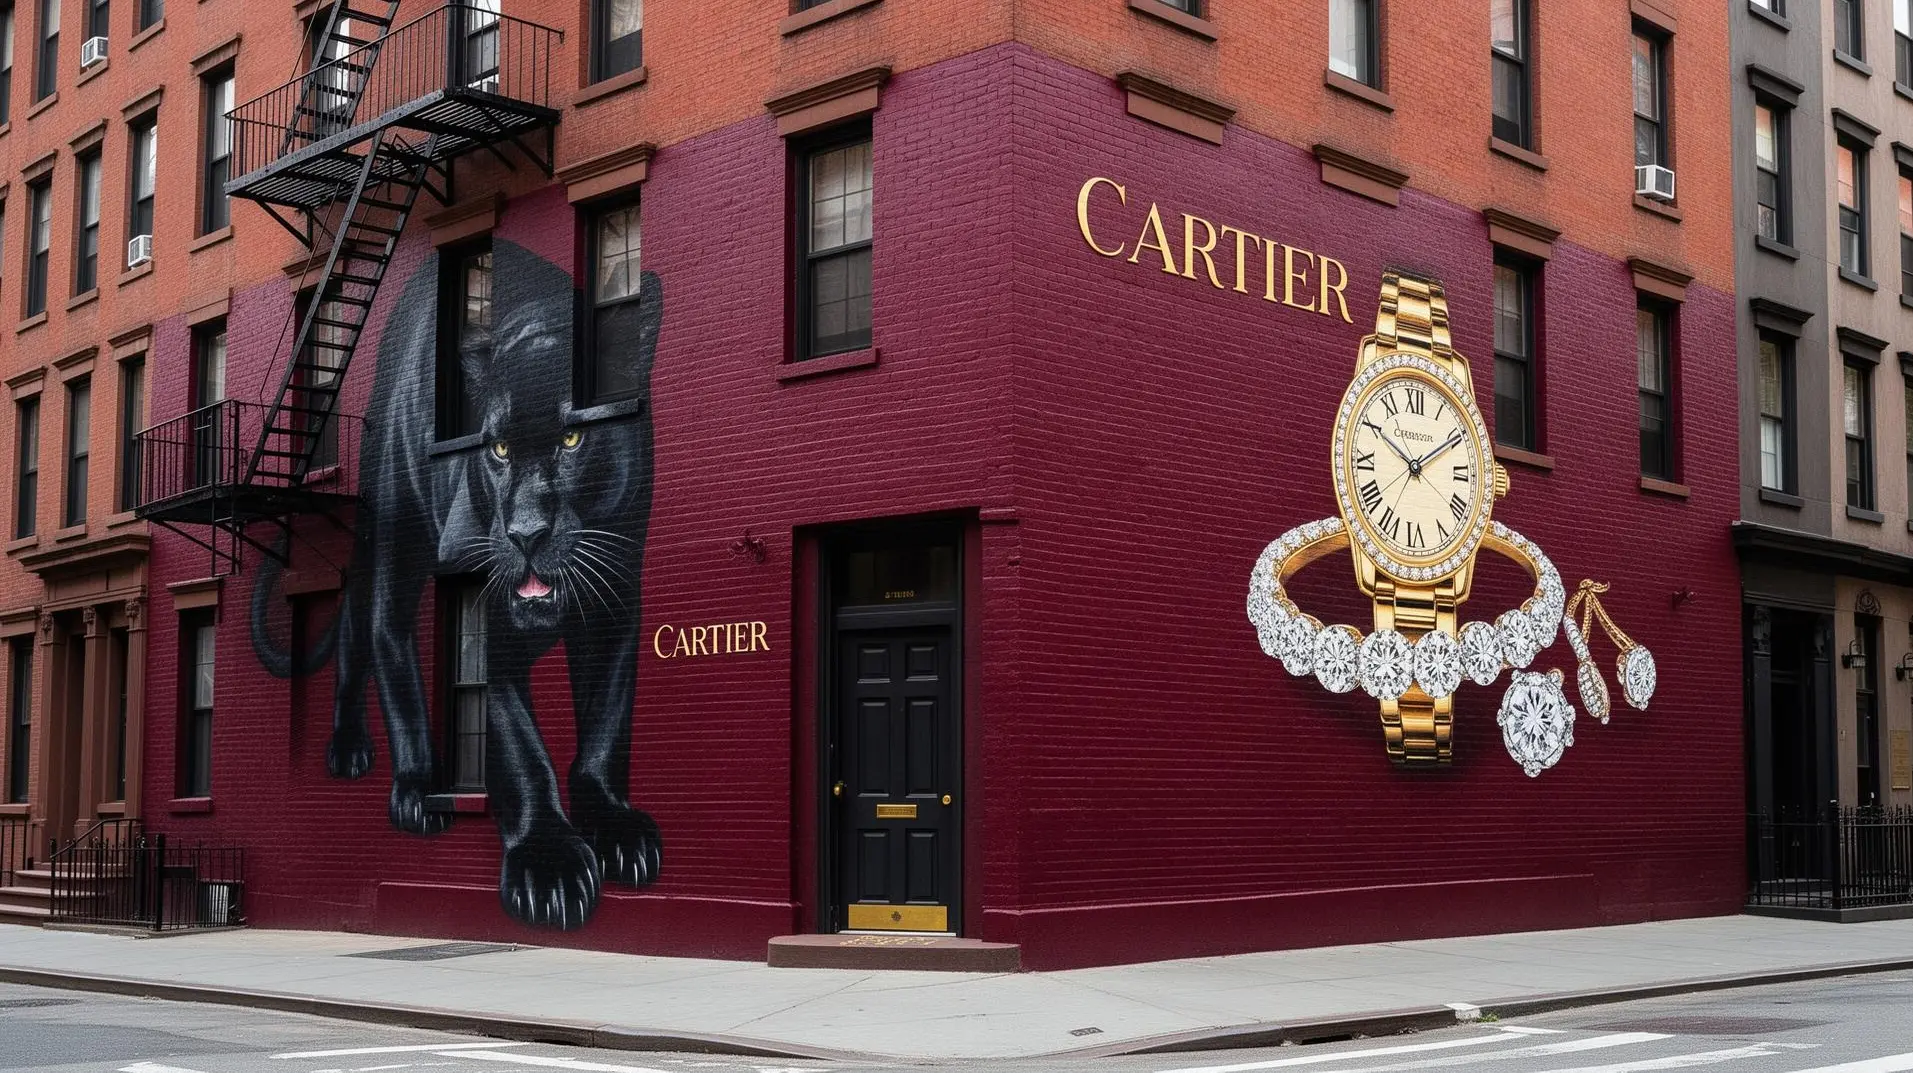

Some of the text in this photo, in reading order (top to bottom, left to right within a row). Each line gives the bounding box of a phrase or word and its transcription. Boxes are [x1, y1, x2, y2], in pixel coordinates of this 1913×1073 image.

[1077, 177, 1354, 324] CARTIER
[1380, 392, 1399, 419] XI
[1405, 388, 1424, 416] XII
[1357, 448, 1375, 472] IX
[654, 621, 770, 659] CARTIER
